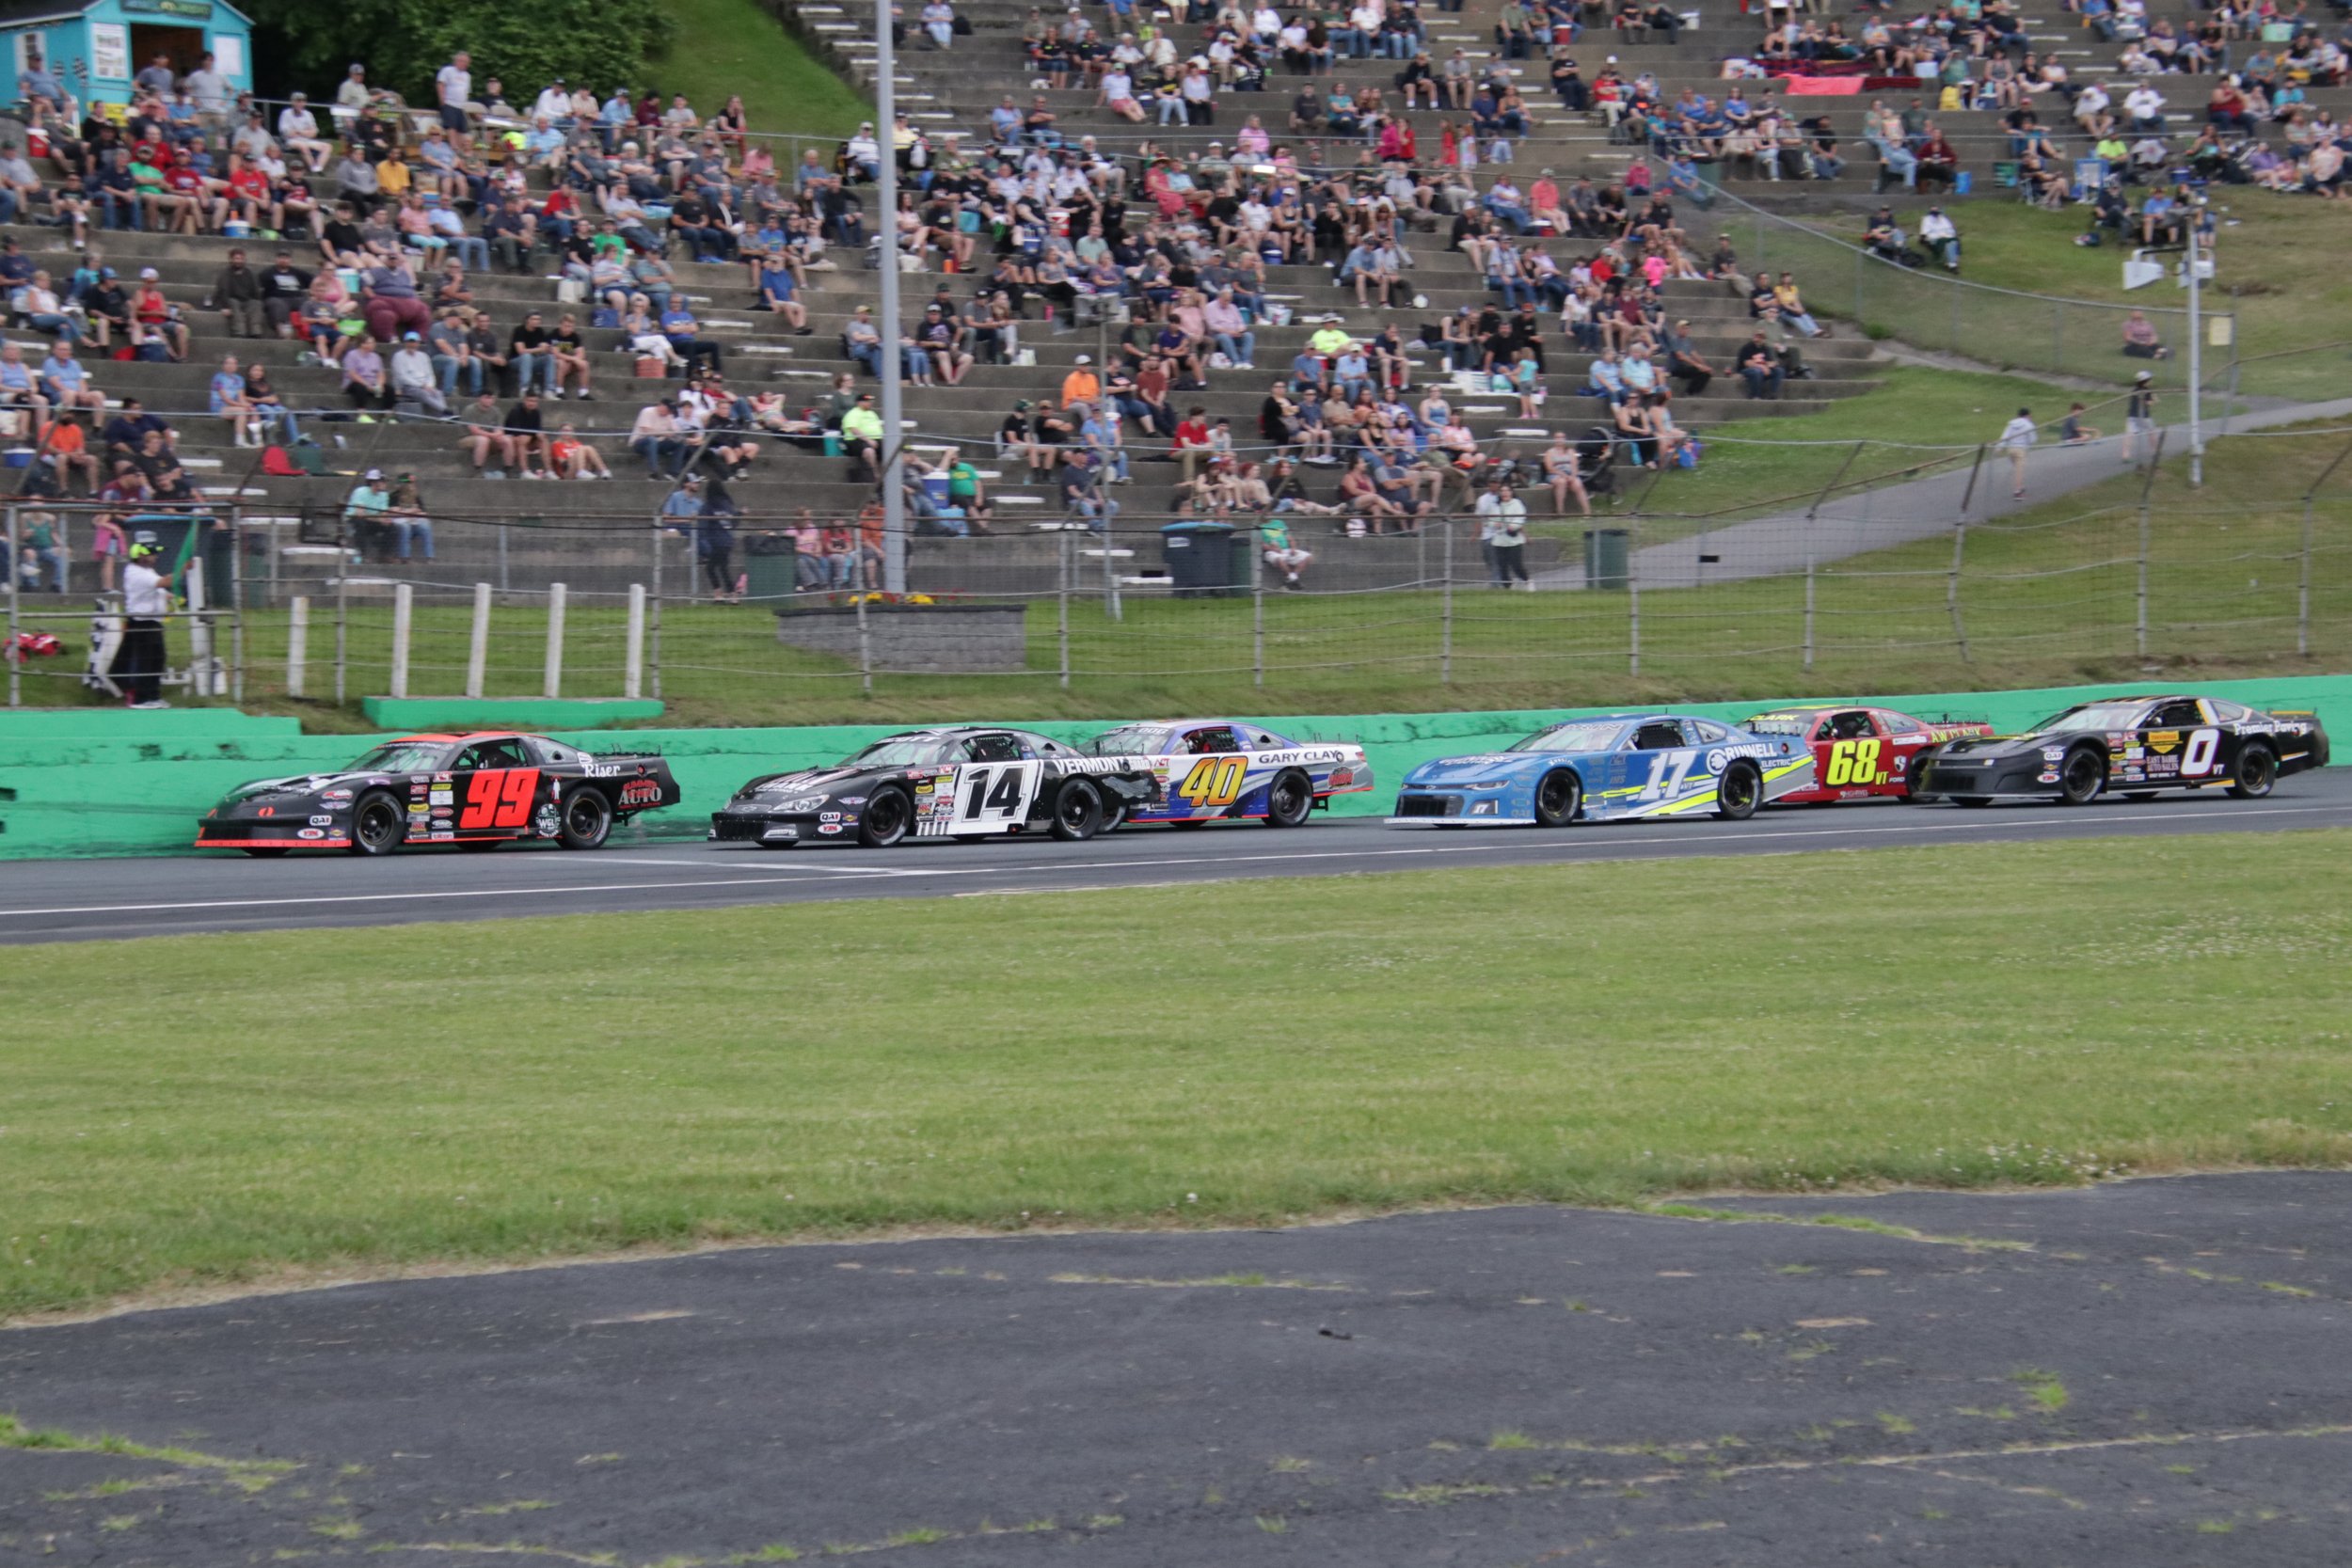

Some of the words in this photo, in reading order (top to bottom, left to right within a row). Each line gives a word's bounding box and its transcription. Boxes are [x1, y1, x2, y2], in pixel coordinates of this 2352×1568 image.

[2233, 721, 2273, 736] Premier
[1259, 752, 1300, 764] GARY
[1825, 738, 1882, 787] 68
[2181, 729, 2220, 778] 0
[582, 763, 621, 778] Riser
[1053, 756, 1129, 775] VERMONT
[1760, 759, 1792, 768] ELECTRIC
[2213, 764, 2225, 775] VT
[1178, 755, 1248, 807] 40
[1639, 751, 1697, 801] 17
[1876, 771, 1888, 784] VT
[459, 768, 541, 829] 99
[618, 786, 662, 806] AUTO
[961, 764, 1028, 823] 14
[1472, 802, 1490, 814] 17
